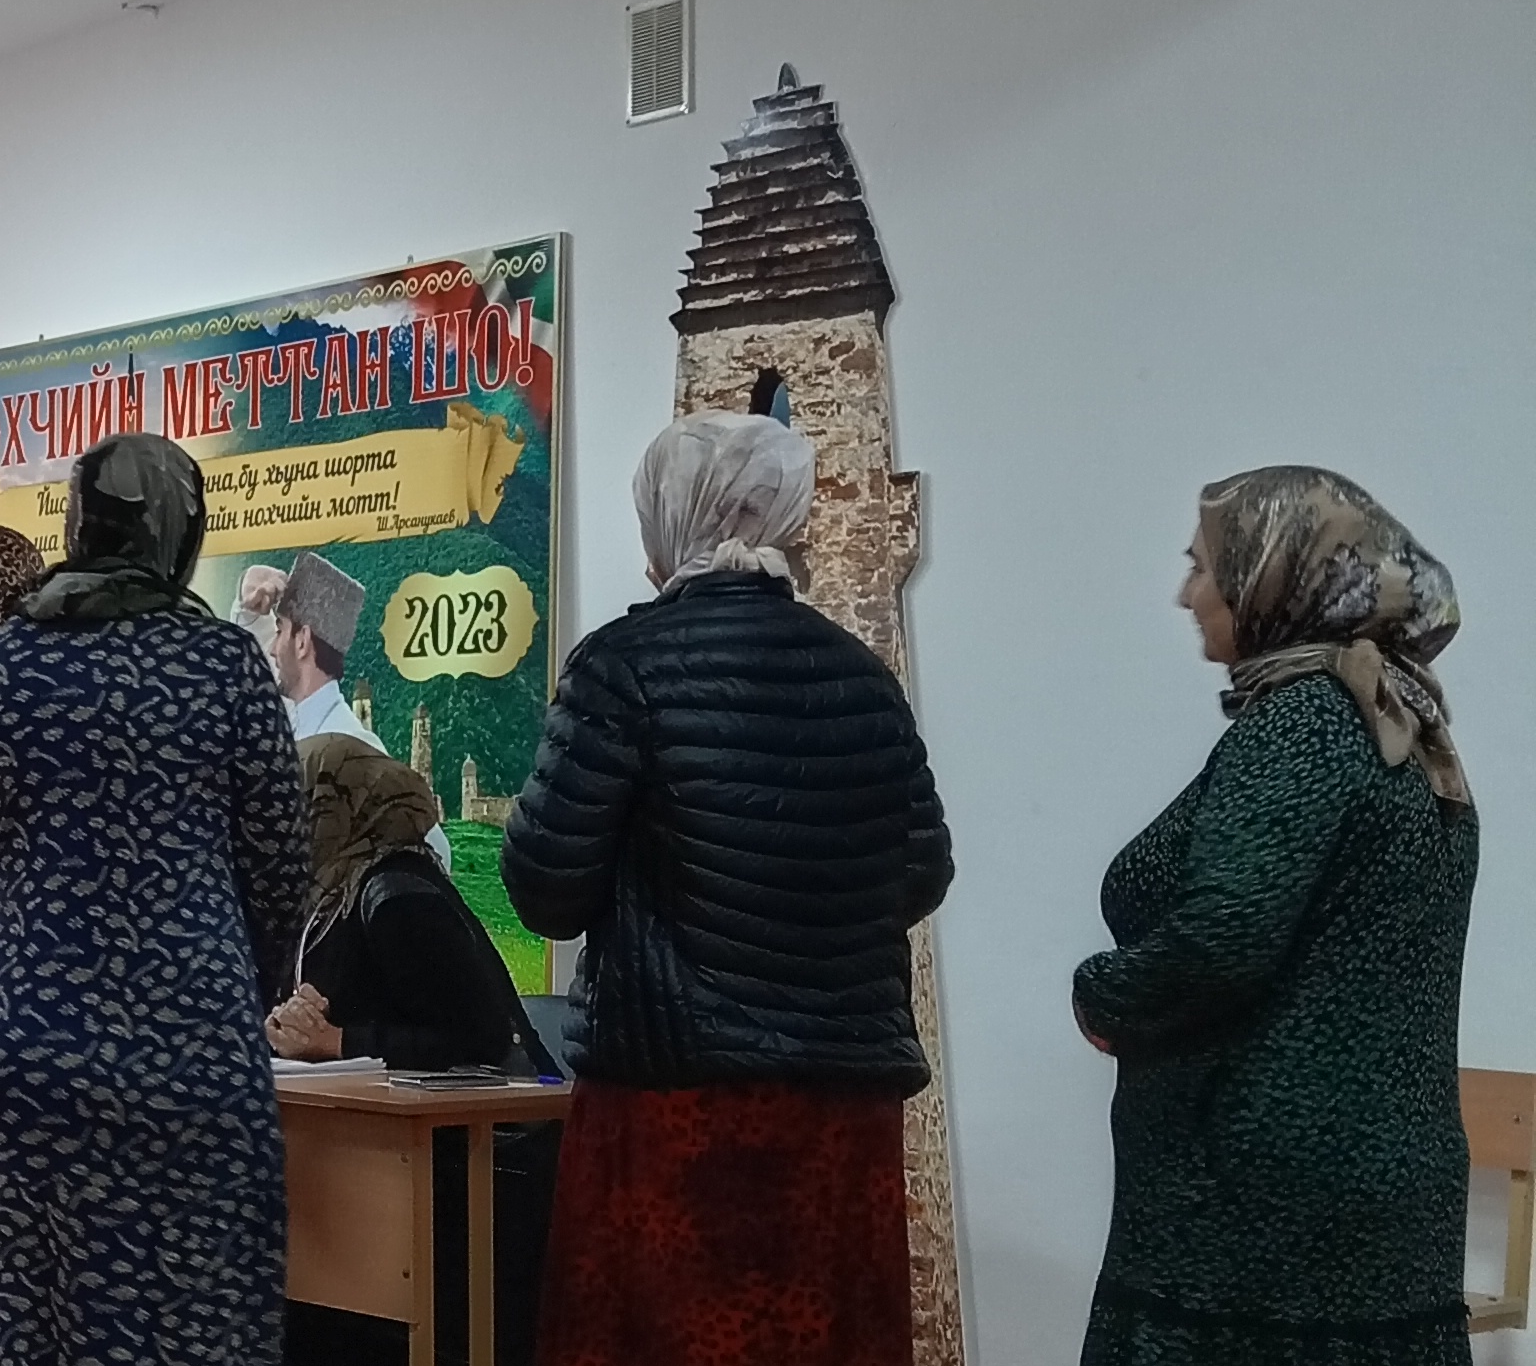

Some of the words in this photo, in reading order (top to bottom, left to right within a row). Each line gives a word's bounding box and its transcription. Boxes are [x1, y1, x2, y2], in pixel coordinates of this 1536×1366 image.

[162, 325, 392, 441] МЕТТАН
[409, 297, 535, 405] ШО!
[263, 460, 319, 496] хьуна
[324, 449, 397, 487] шорта
[243, 495, 322, 528] нохчийн
[327, 481, 401, 517] мотт!
[403, 589, 509, 658] 2023
